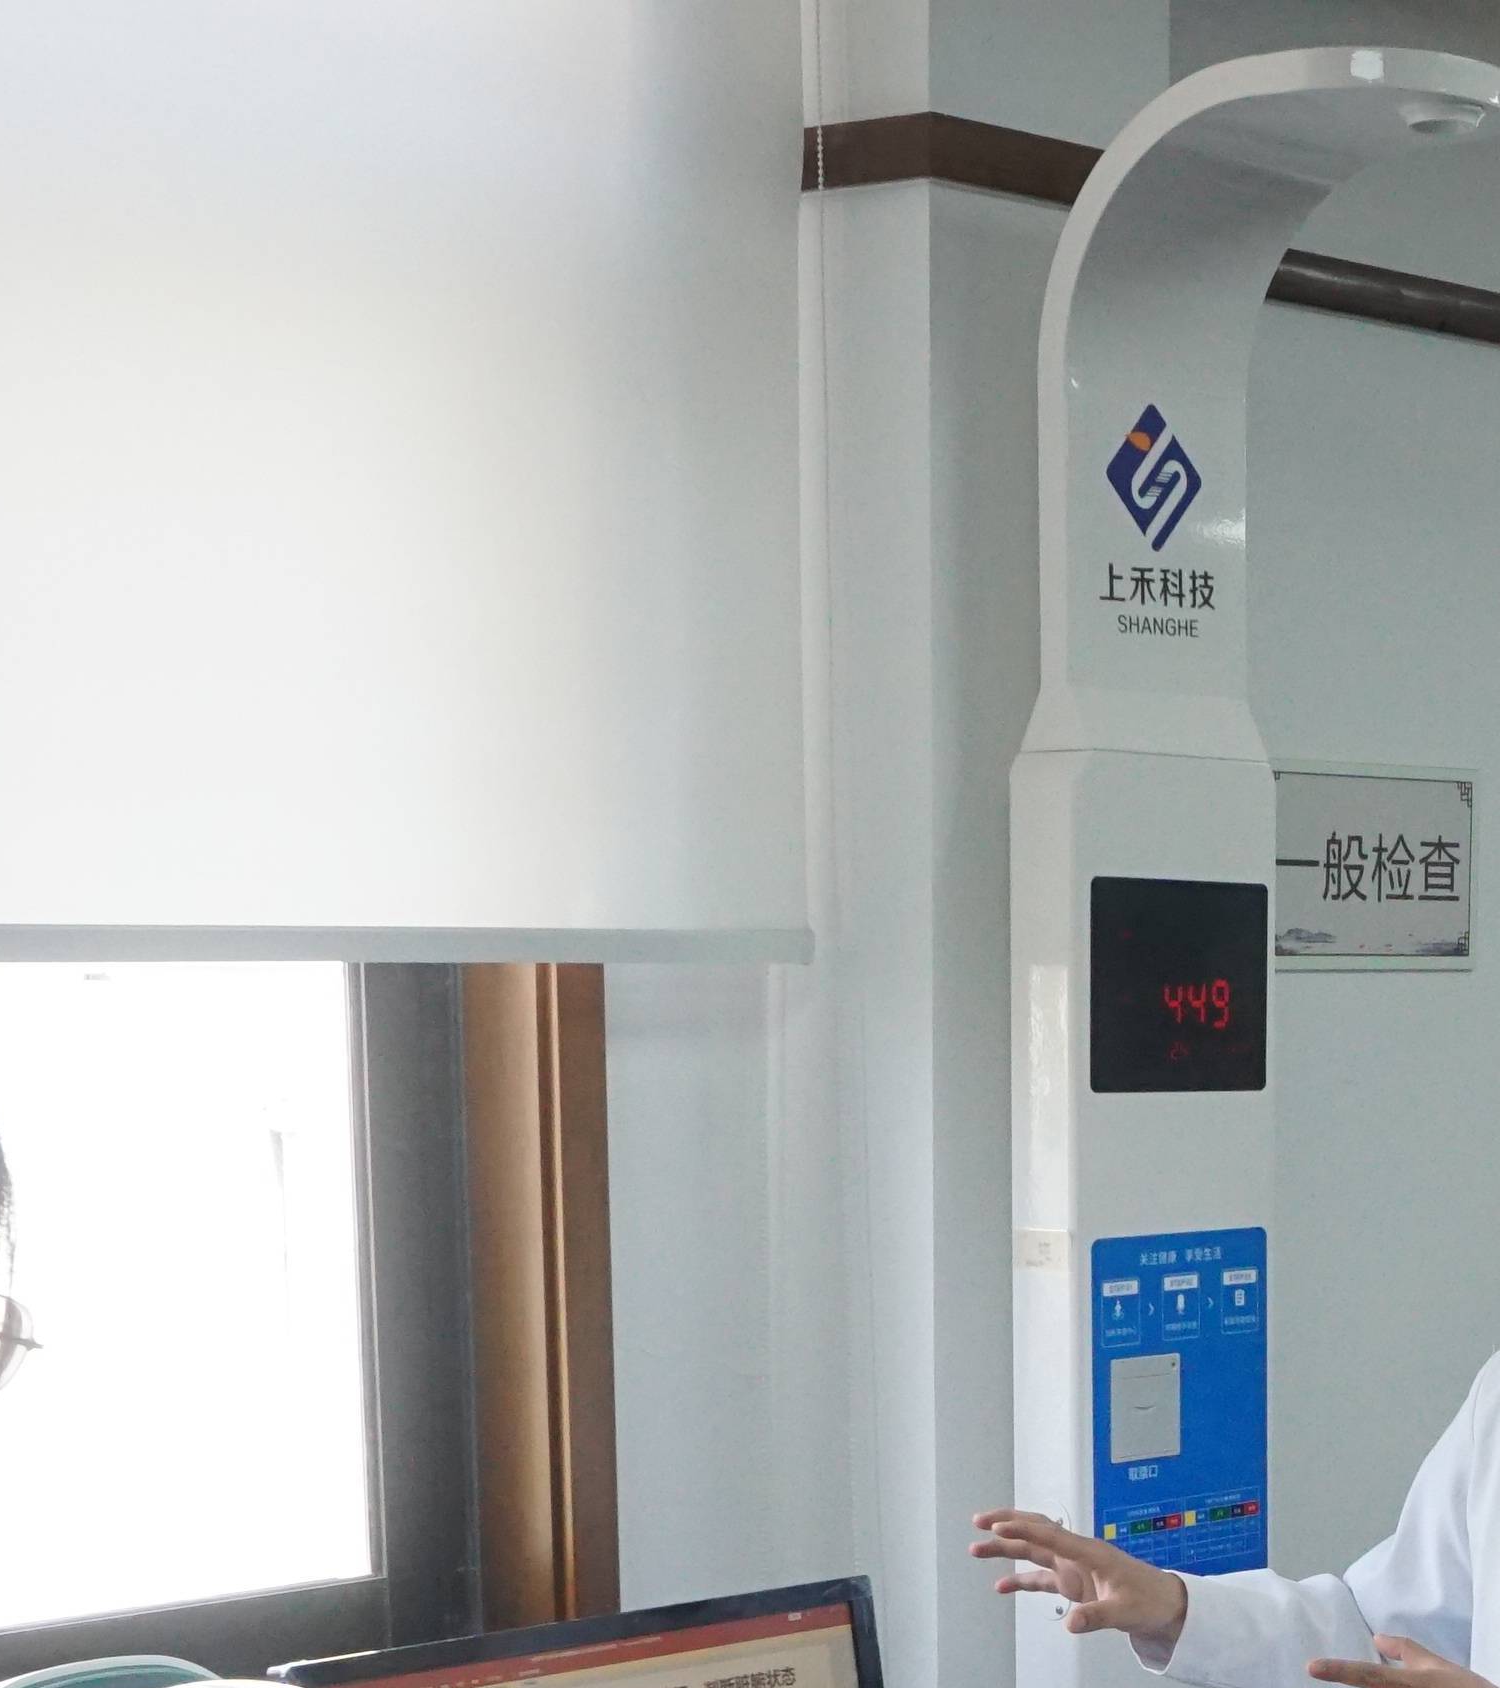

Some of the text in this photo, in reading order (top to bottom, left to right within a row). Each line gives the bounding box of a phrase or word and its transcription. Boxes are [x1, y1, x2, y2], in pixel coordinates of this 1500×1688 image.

[1099, 563, 1216, 611] 上禾科技
[1116, 613, 1200, 639] SHANGHE
[1275, 830, 1461, 903] 一般检查
[1163, 977, 1231, 1031] 449
